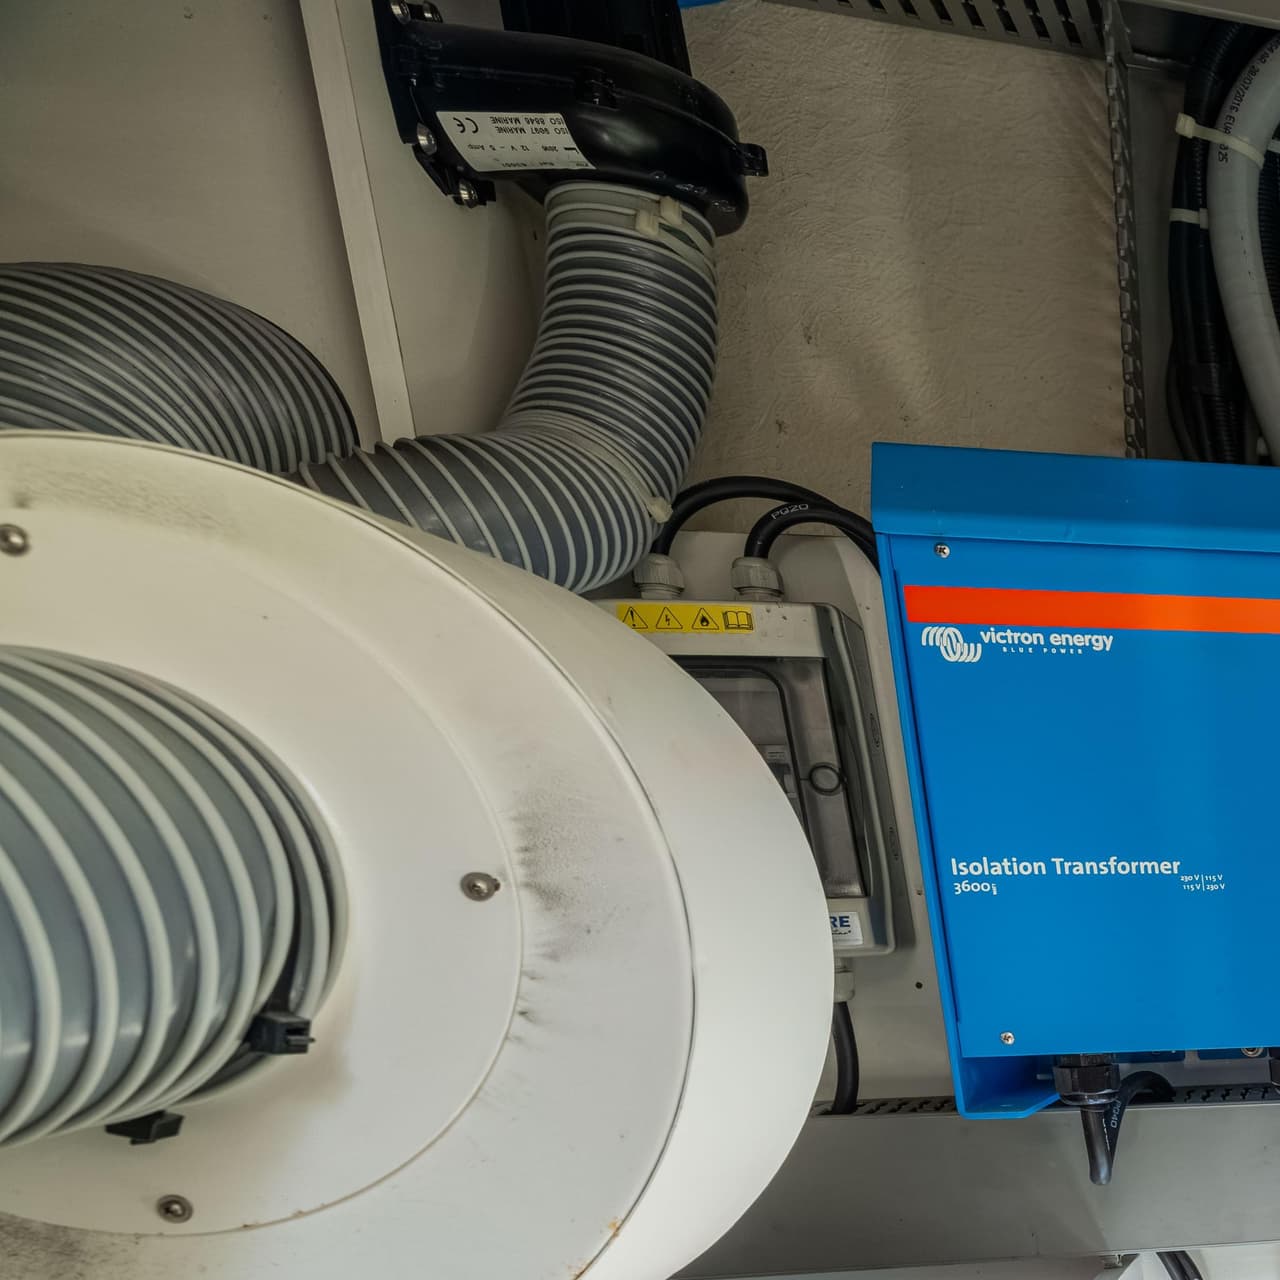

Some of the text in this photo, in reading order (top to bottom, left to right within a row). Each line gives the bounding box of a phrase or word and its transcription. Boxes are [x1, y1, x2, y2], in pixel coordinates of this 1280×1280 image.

[489, 116, 520, 125] MARINE
[495, 127, 527, 135] MARINE
[980, 627, 1113, 652] victron energy
[1043, 647, 1083, 655] POWER
[951, 856, 1180, 876] Isolation Transformer
